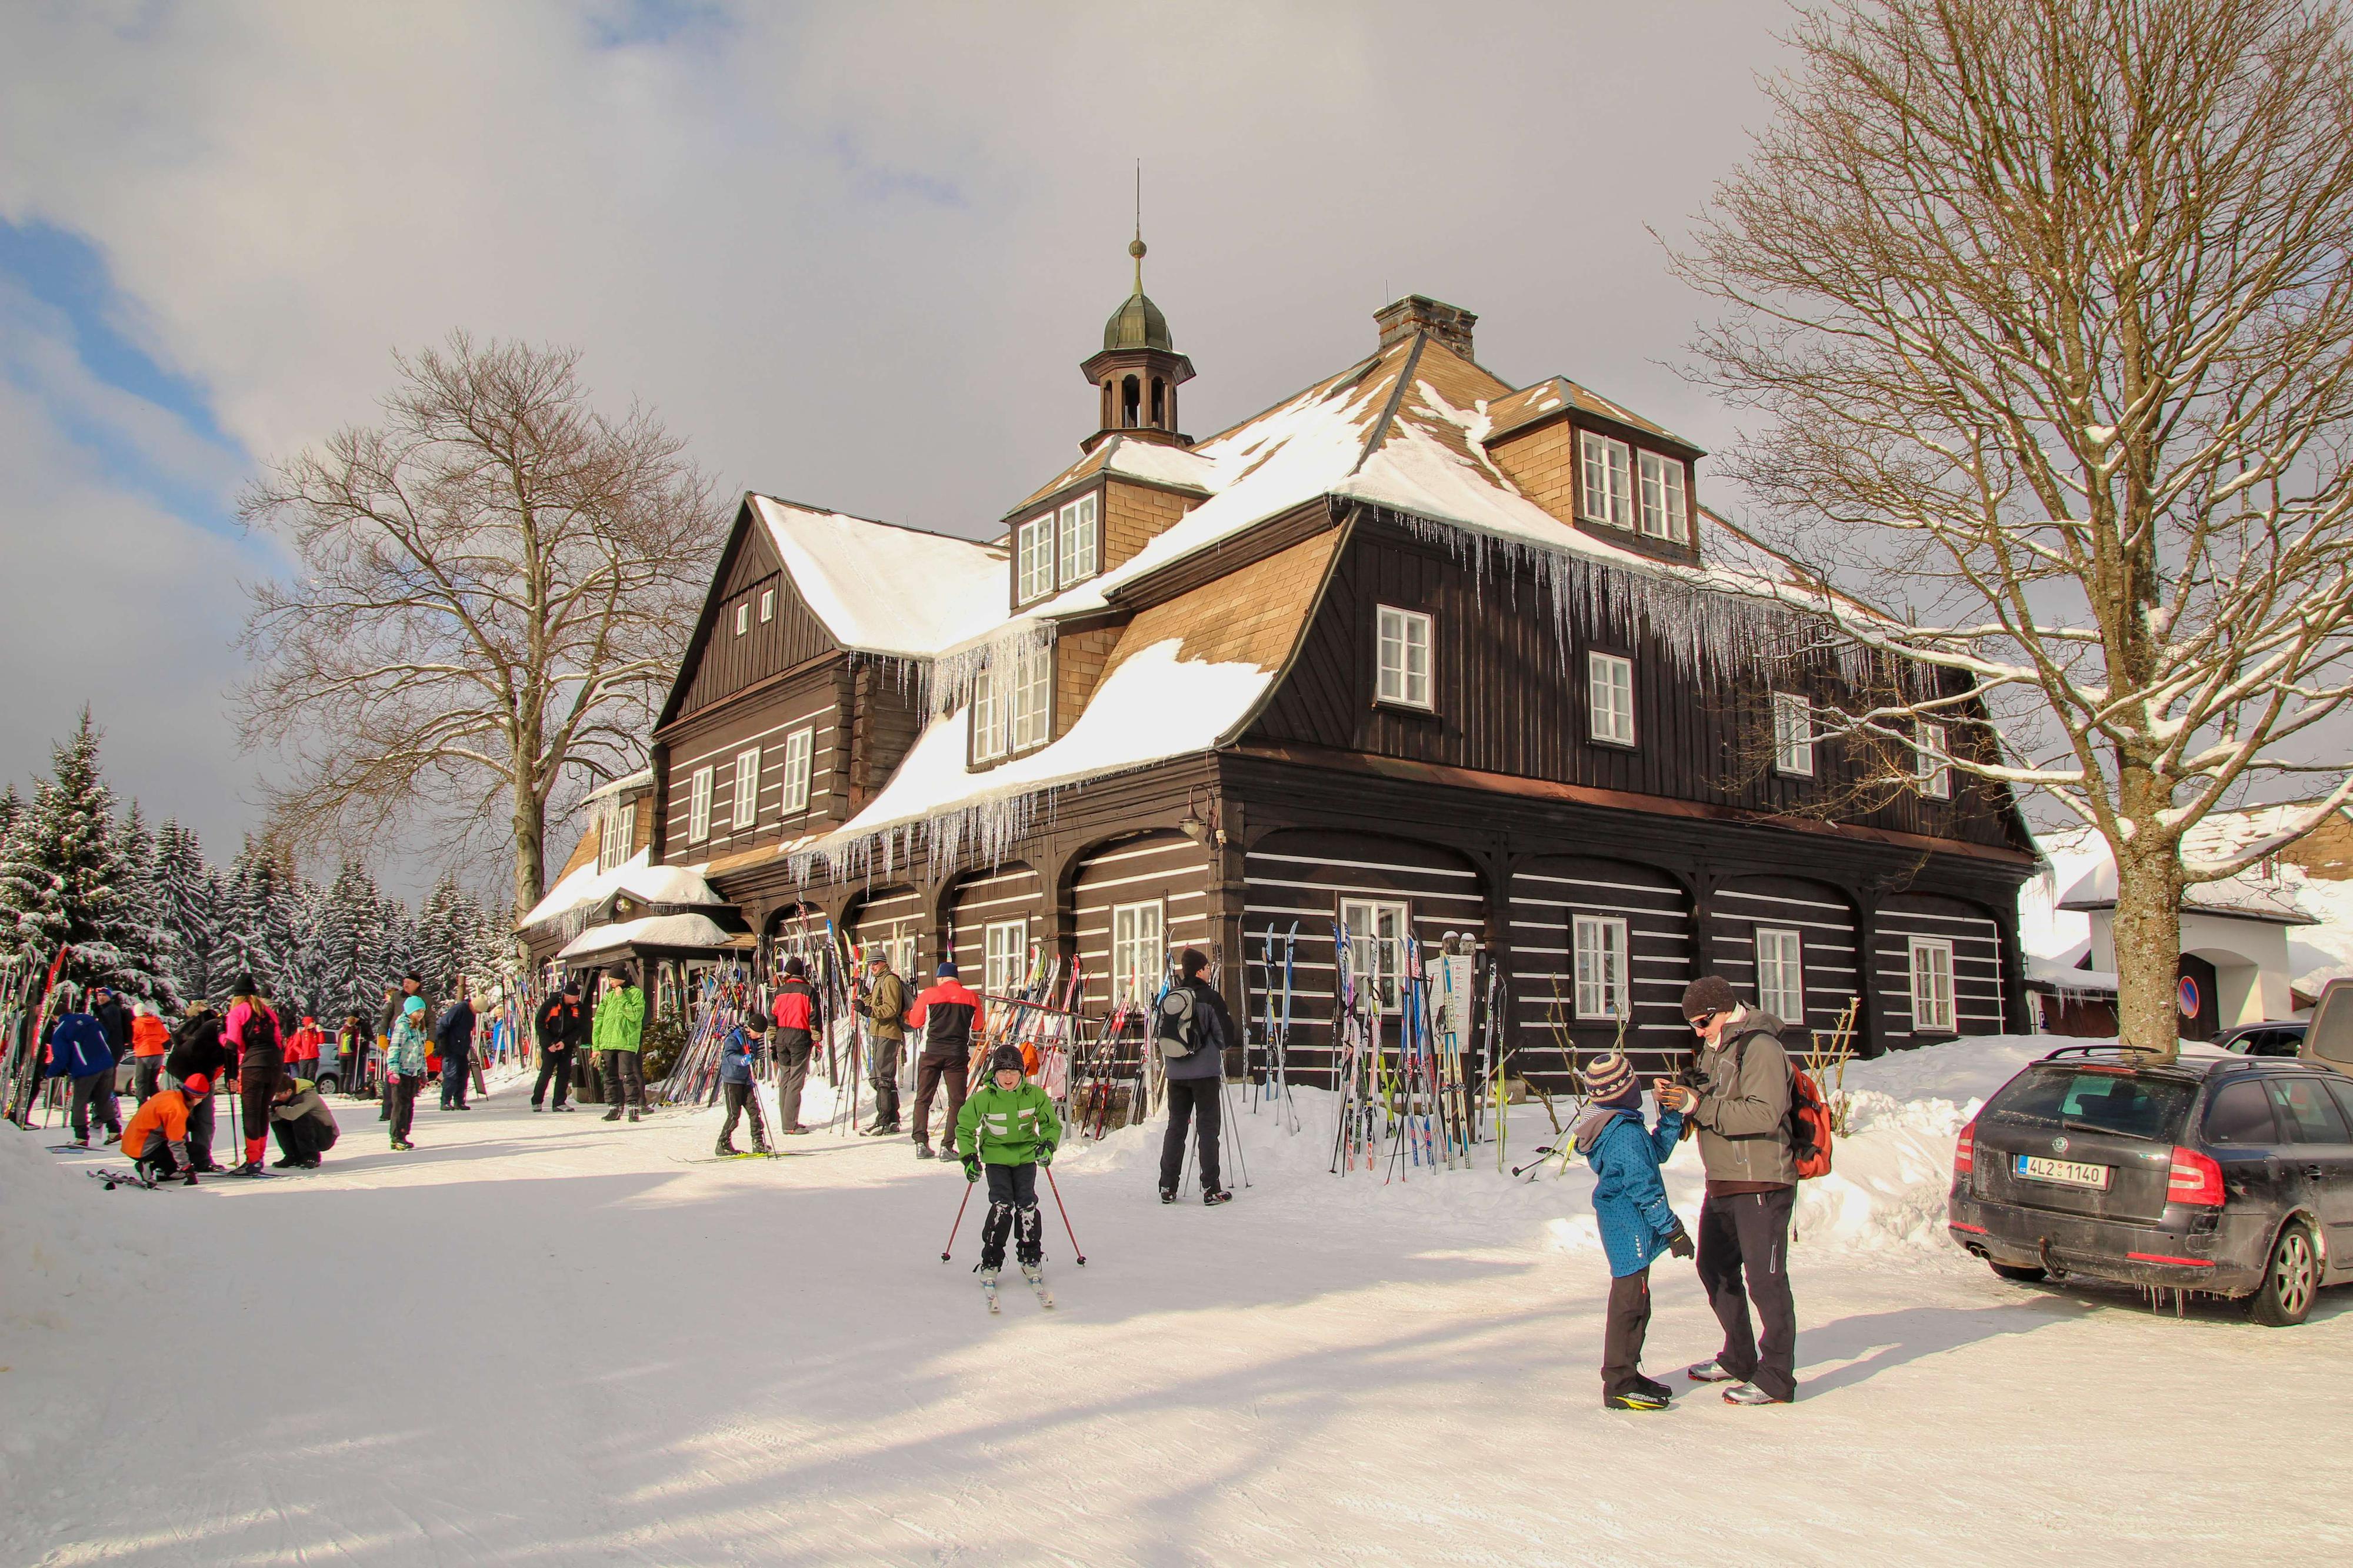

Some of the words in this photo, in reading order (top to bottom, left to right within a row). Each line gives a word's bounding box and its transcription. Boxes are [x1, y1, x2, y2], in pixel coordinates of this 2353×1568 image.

[2040, 1012, 2045, 1027] P
[2029, 1159, 2054, 1176] 4L2
[2067, 1165, 2099, 1182] 1140
